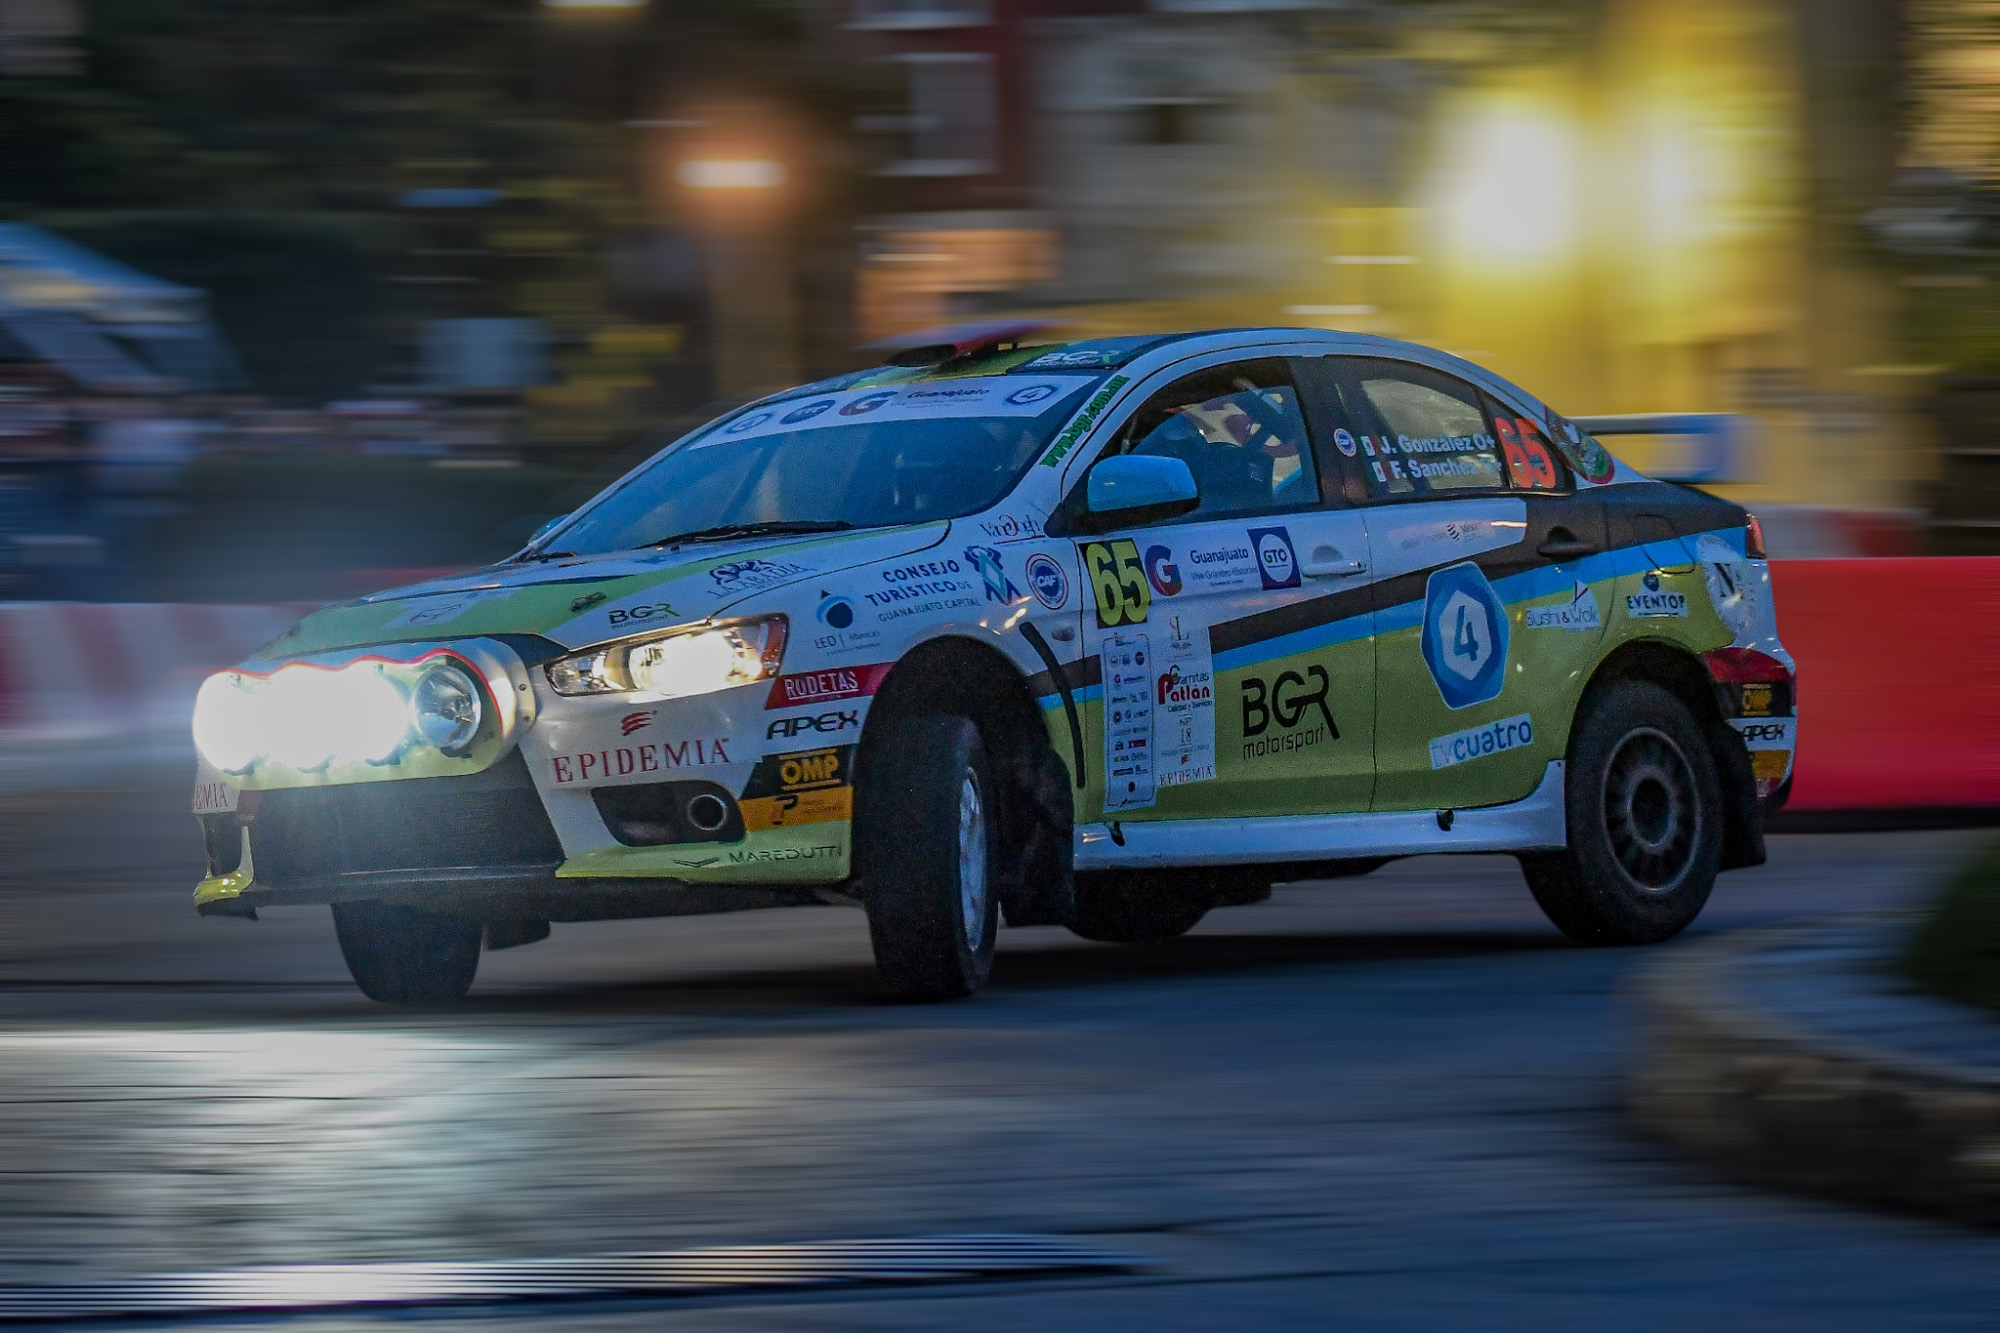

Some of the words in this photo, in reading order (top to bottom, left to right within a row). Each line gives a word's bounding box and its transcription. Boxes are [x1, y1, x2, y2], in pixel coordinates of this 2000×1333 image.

[907, 387, 990, 399] Guanajuato
[1039, 374, 1130, 468] www.bgr.com.mx
[1381, 435, 1397, 455] J.
[1397, 433, 1475, 454] Gonzalez
[1494, 417, 1557, 489] 65
[1389, 460, 1408, 479] F.
[1407, 457, 1478, 479] Sanchez
[1189, 547, 1249, 564] Guanajuato
[1263, 548, 1288, 564] GTO
[882, 558, 961, 583] CONSEJO
[1036, 574, 1057, 588] CAF
[1085, 541, 1151, 626] 65
[864, 580, 957, 607] TURÍSTICO
[957, 580, 973, 590] DE
[608, 602, 681, 625] BGR
[878, 601, 944, 623] GUANAJUATO
[944, 598, 982, 610] CAPITAL
[1453, 604, 1480, 662] 4
[784, 671, 859, 697] RODETAS
[1241, 664, 1341, 740] BGR
[766, 709, 859, 740] APEX
[1242, 722, 1325, 761] motorsport
[553, 737, 731, 785] EPIDEMIA
[780, 754, 839, 785] OMP
[1159, 764, 1213, 787] EPIDEMIA
